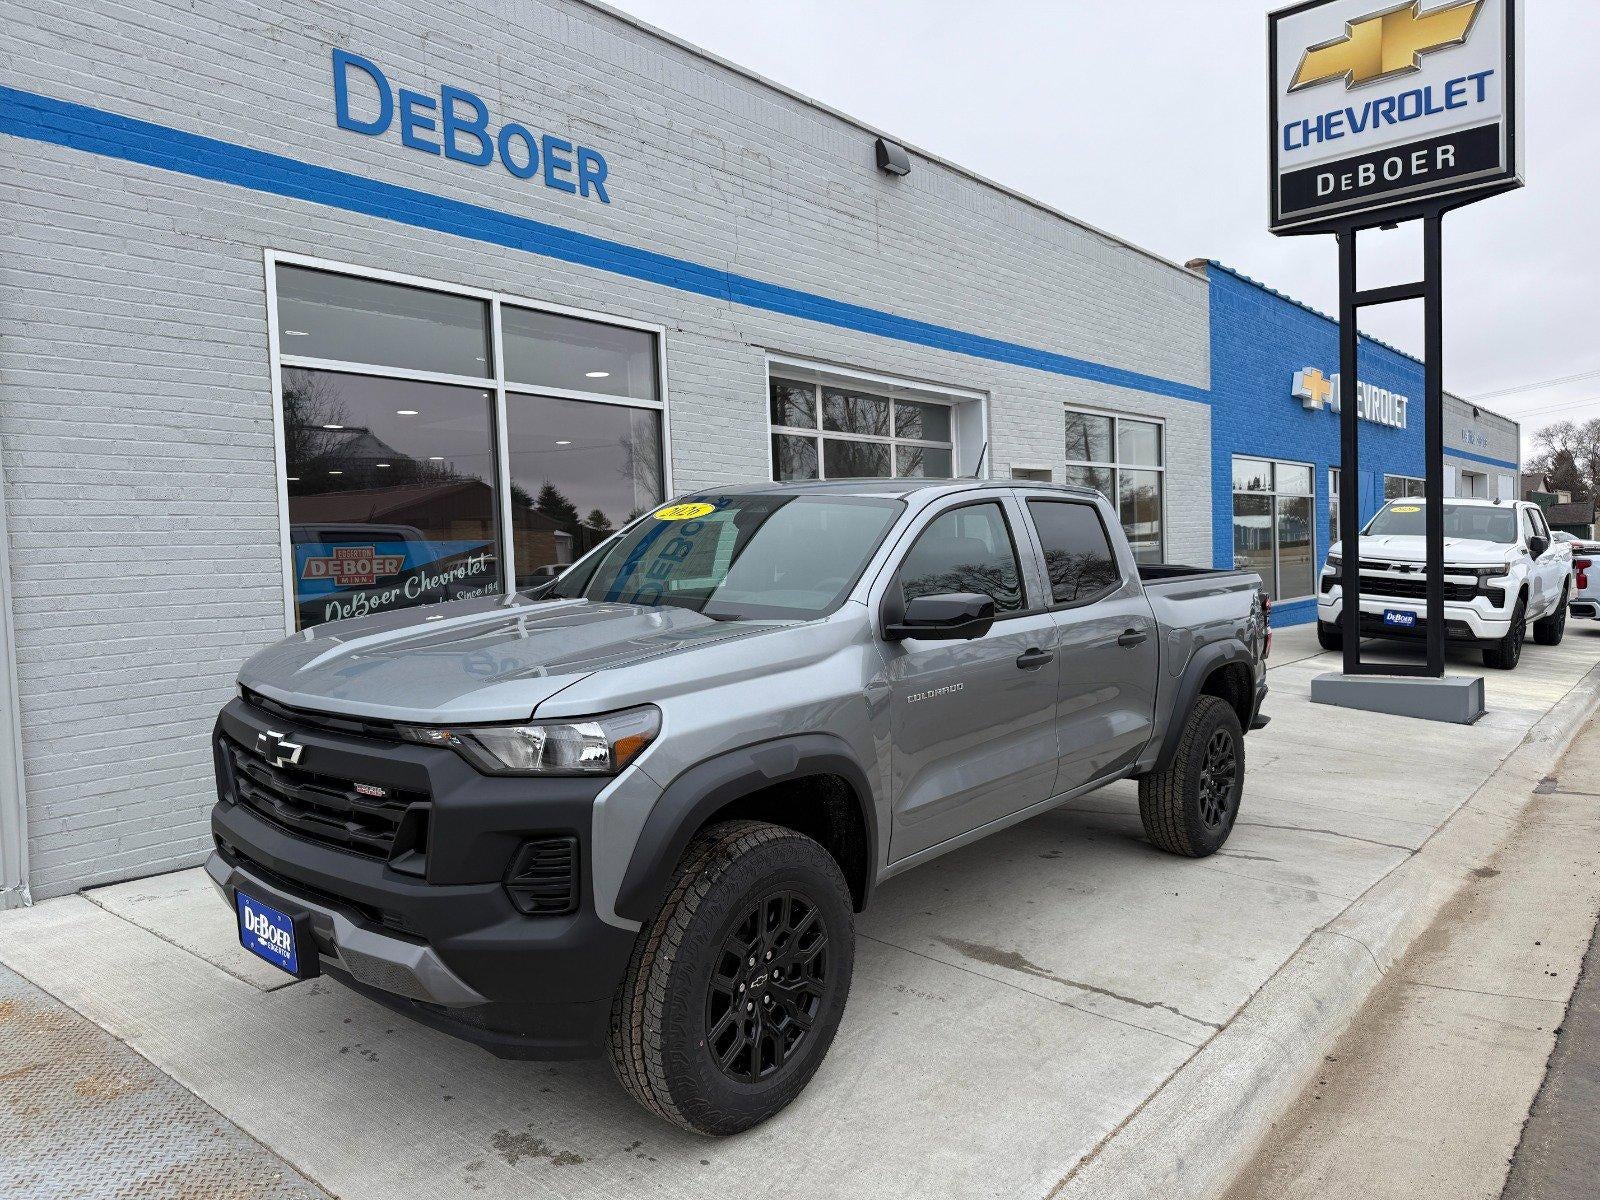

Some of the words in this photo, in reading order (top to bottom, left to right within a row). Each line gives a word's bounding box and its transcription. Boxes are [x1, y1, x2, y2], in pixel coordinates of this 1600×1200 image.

[1283, 69, 1495, 152] CHEVROLET
[1330, 373, 1408, 429] EVROLET
[310, 559, 398, 576] DEBOER
[325, 588, 400, 622] DeBoer
[404, 552, 493, 599] Chevrolet
[456, 588, 482, 600] Since
[907, 682, 964, 704] COLORADO
[267, 941, 291, 960] EDGERTON
